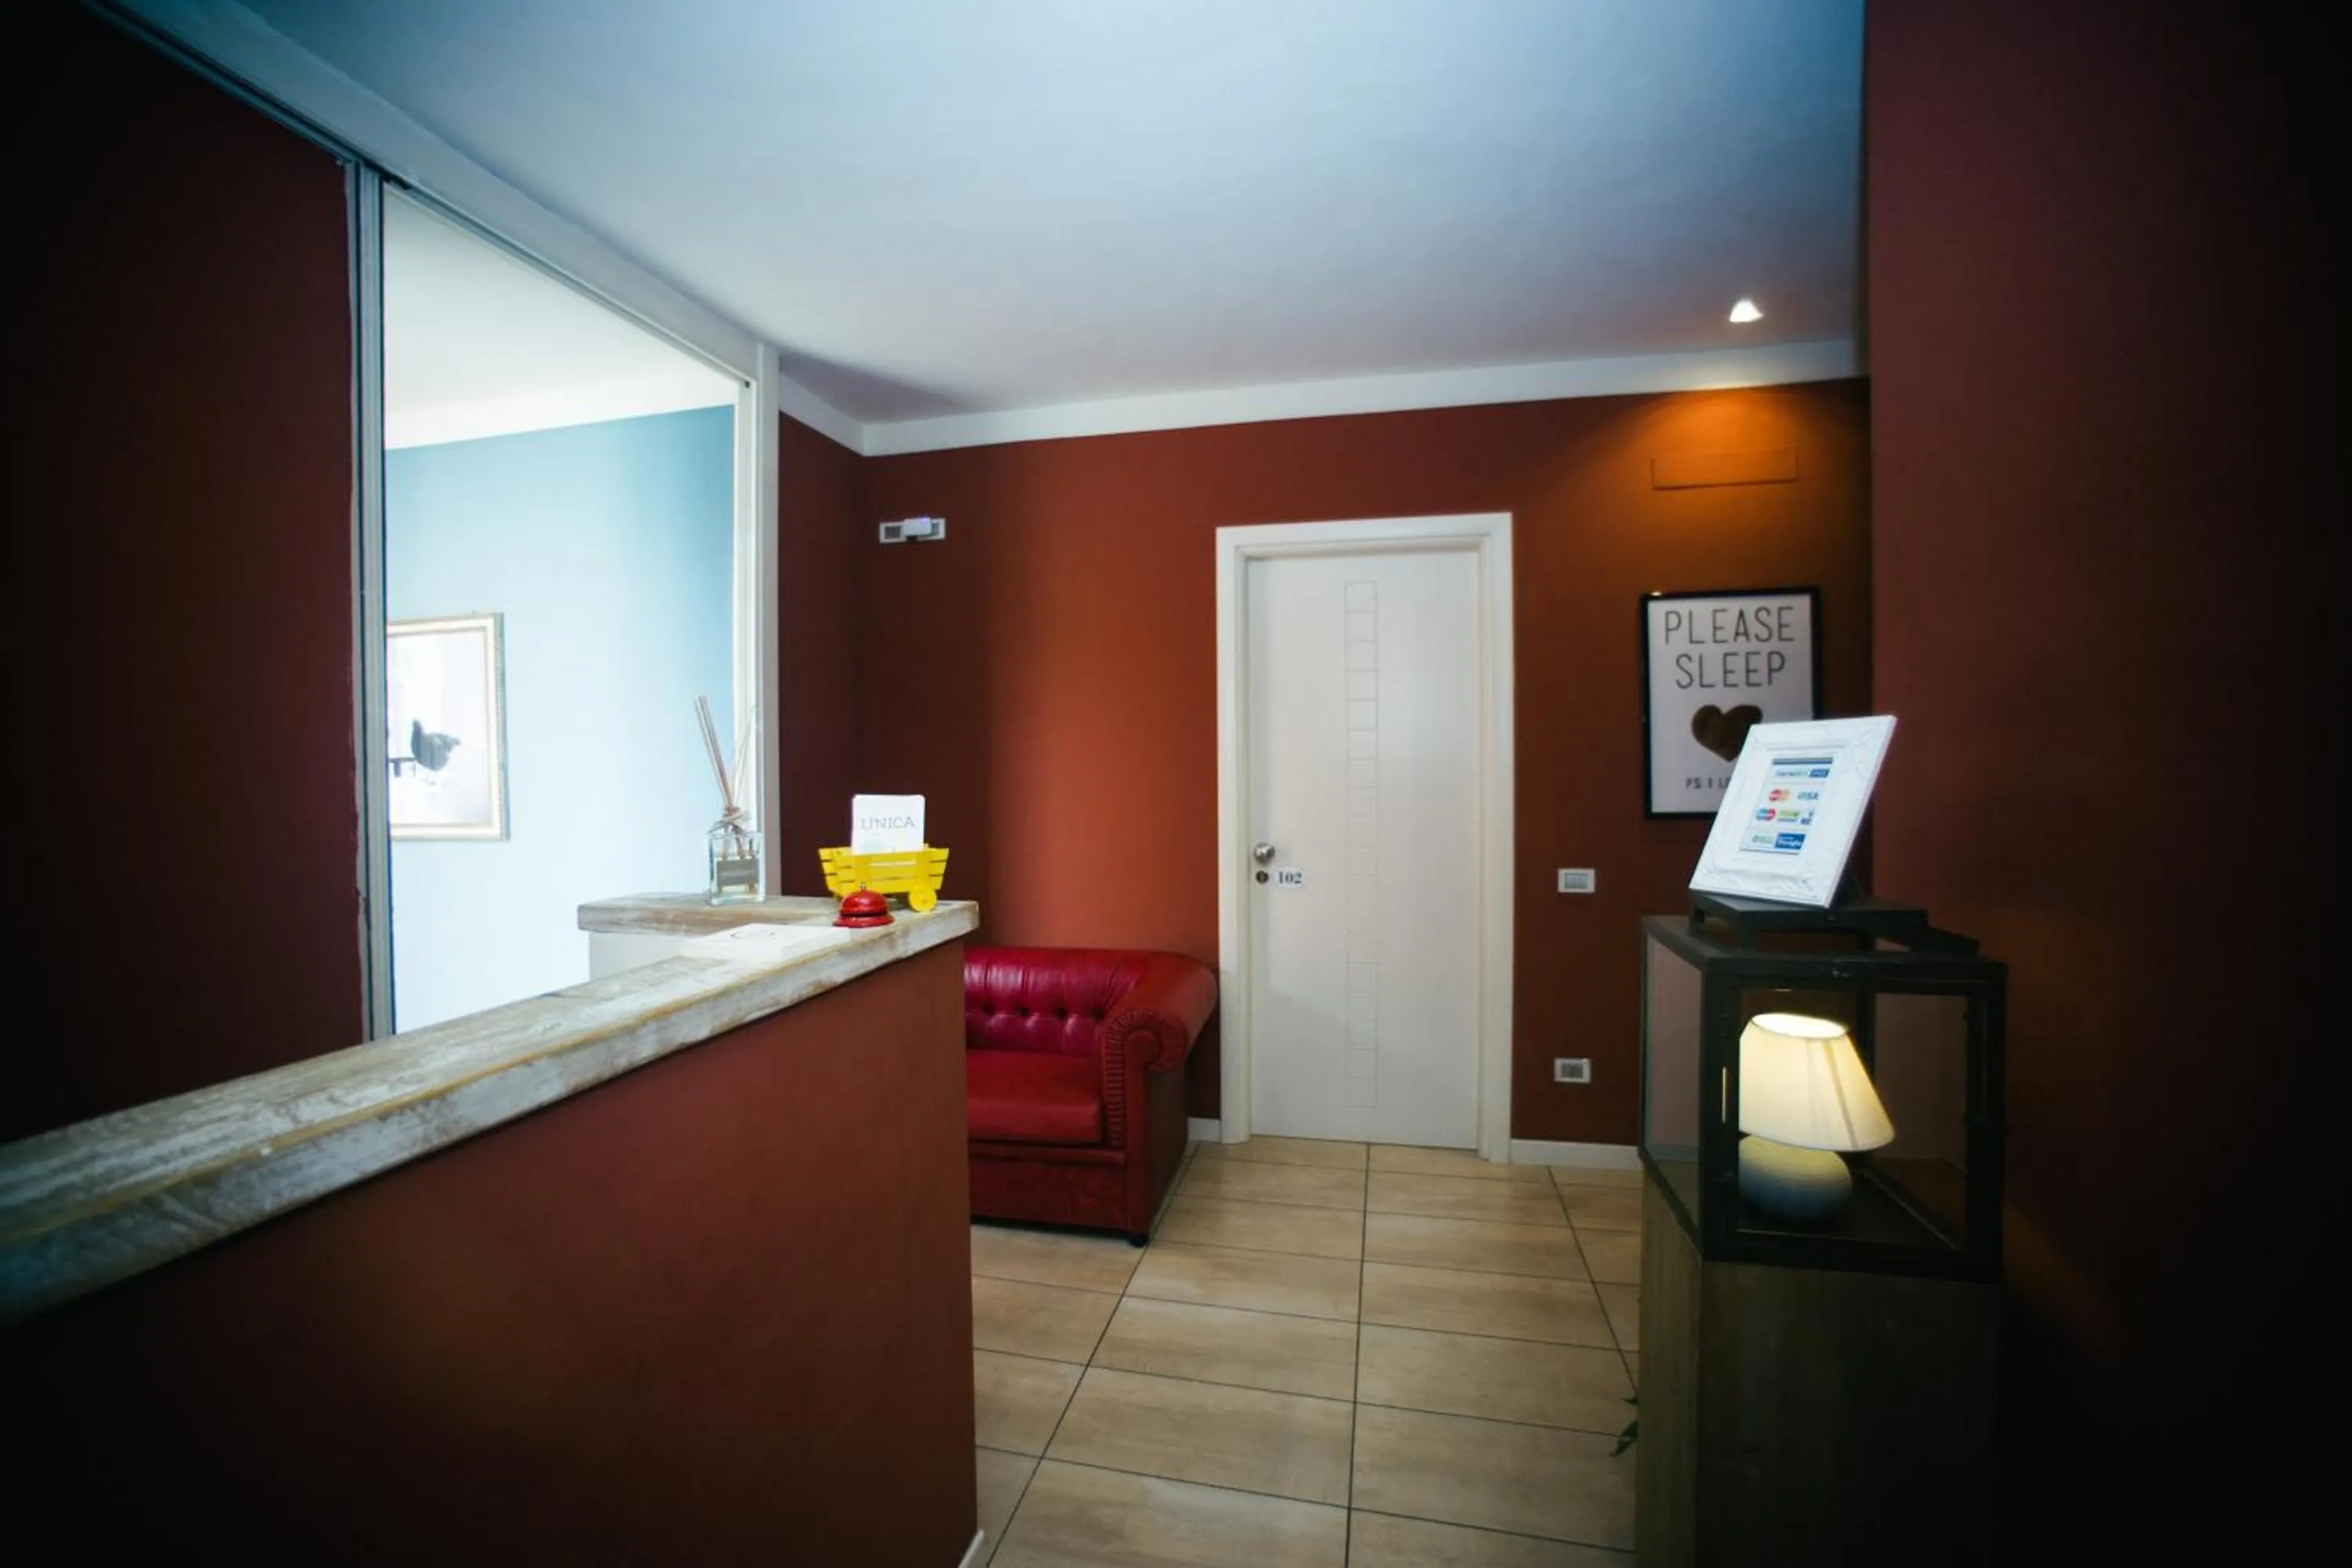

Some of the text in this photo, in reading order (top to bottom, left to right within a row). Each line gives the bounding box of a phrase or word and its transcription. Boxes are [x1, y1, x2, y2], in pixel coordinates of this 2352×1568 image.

[1664, 605, 1795, 645] PLEASE
[1675, 650, 1787, 690] SLEEP
[861, 816, 916, 830] UNICA
[1279, 871, 1303, 884] 102
